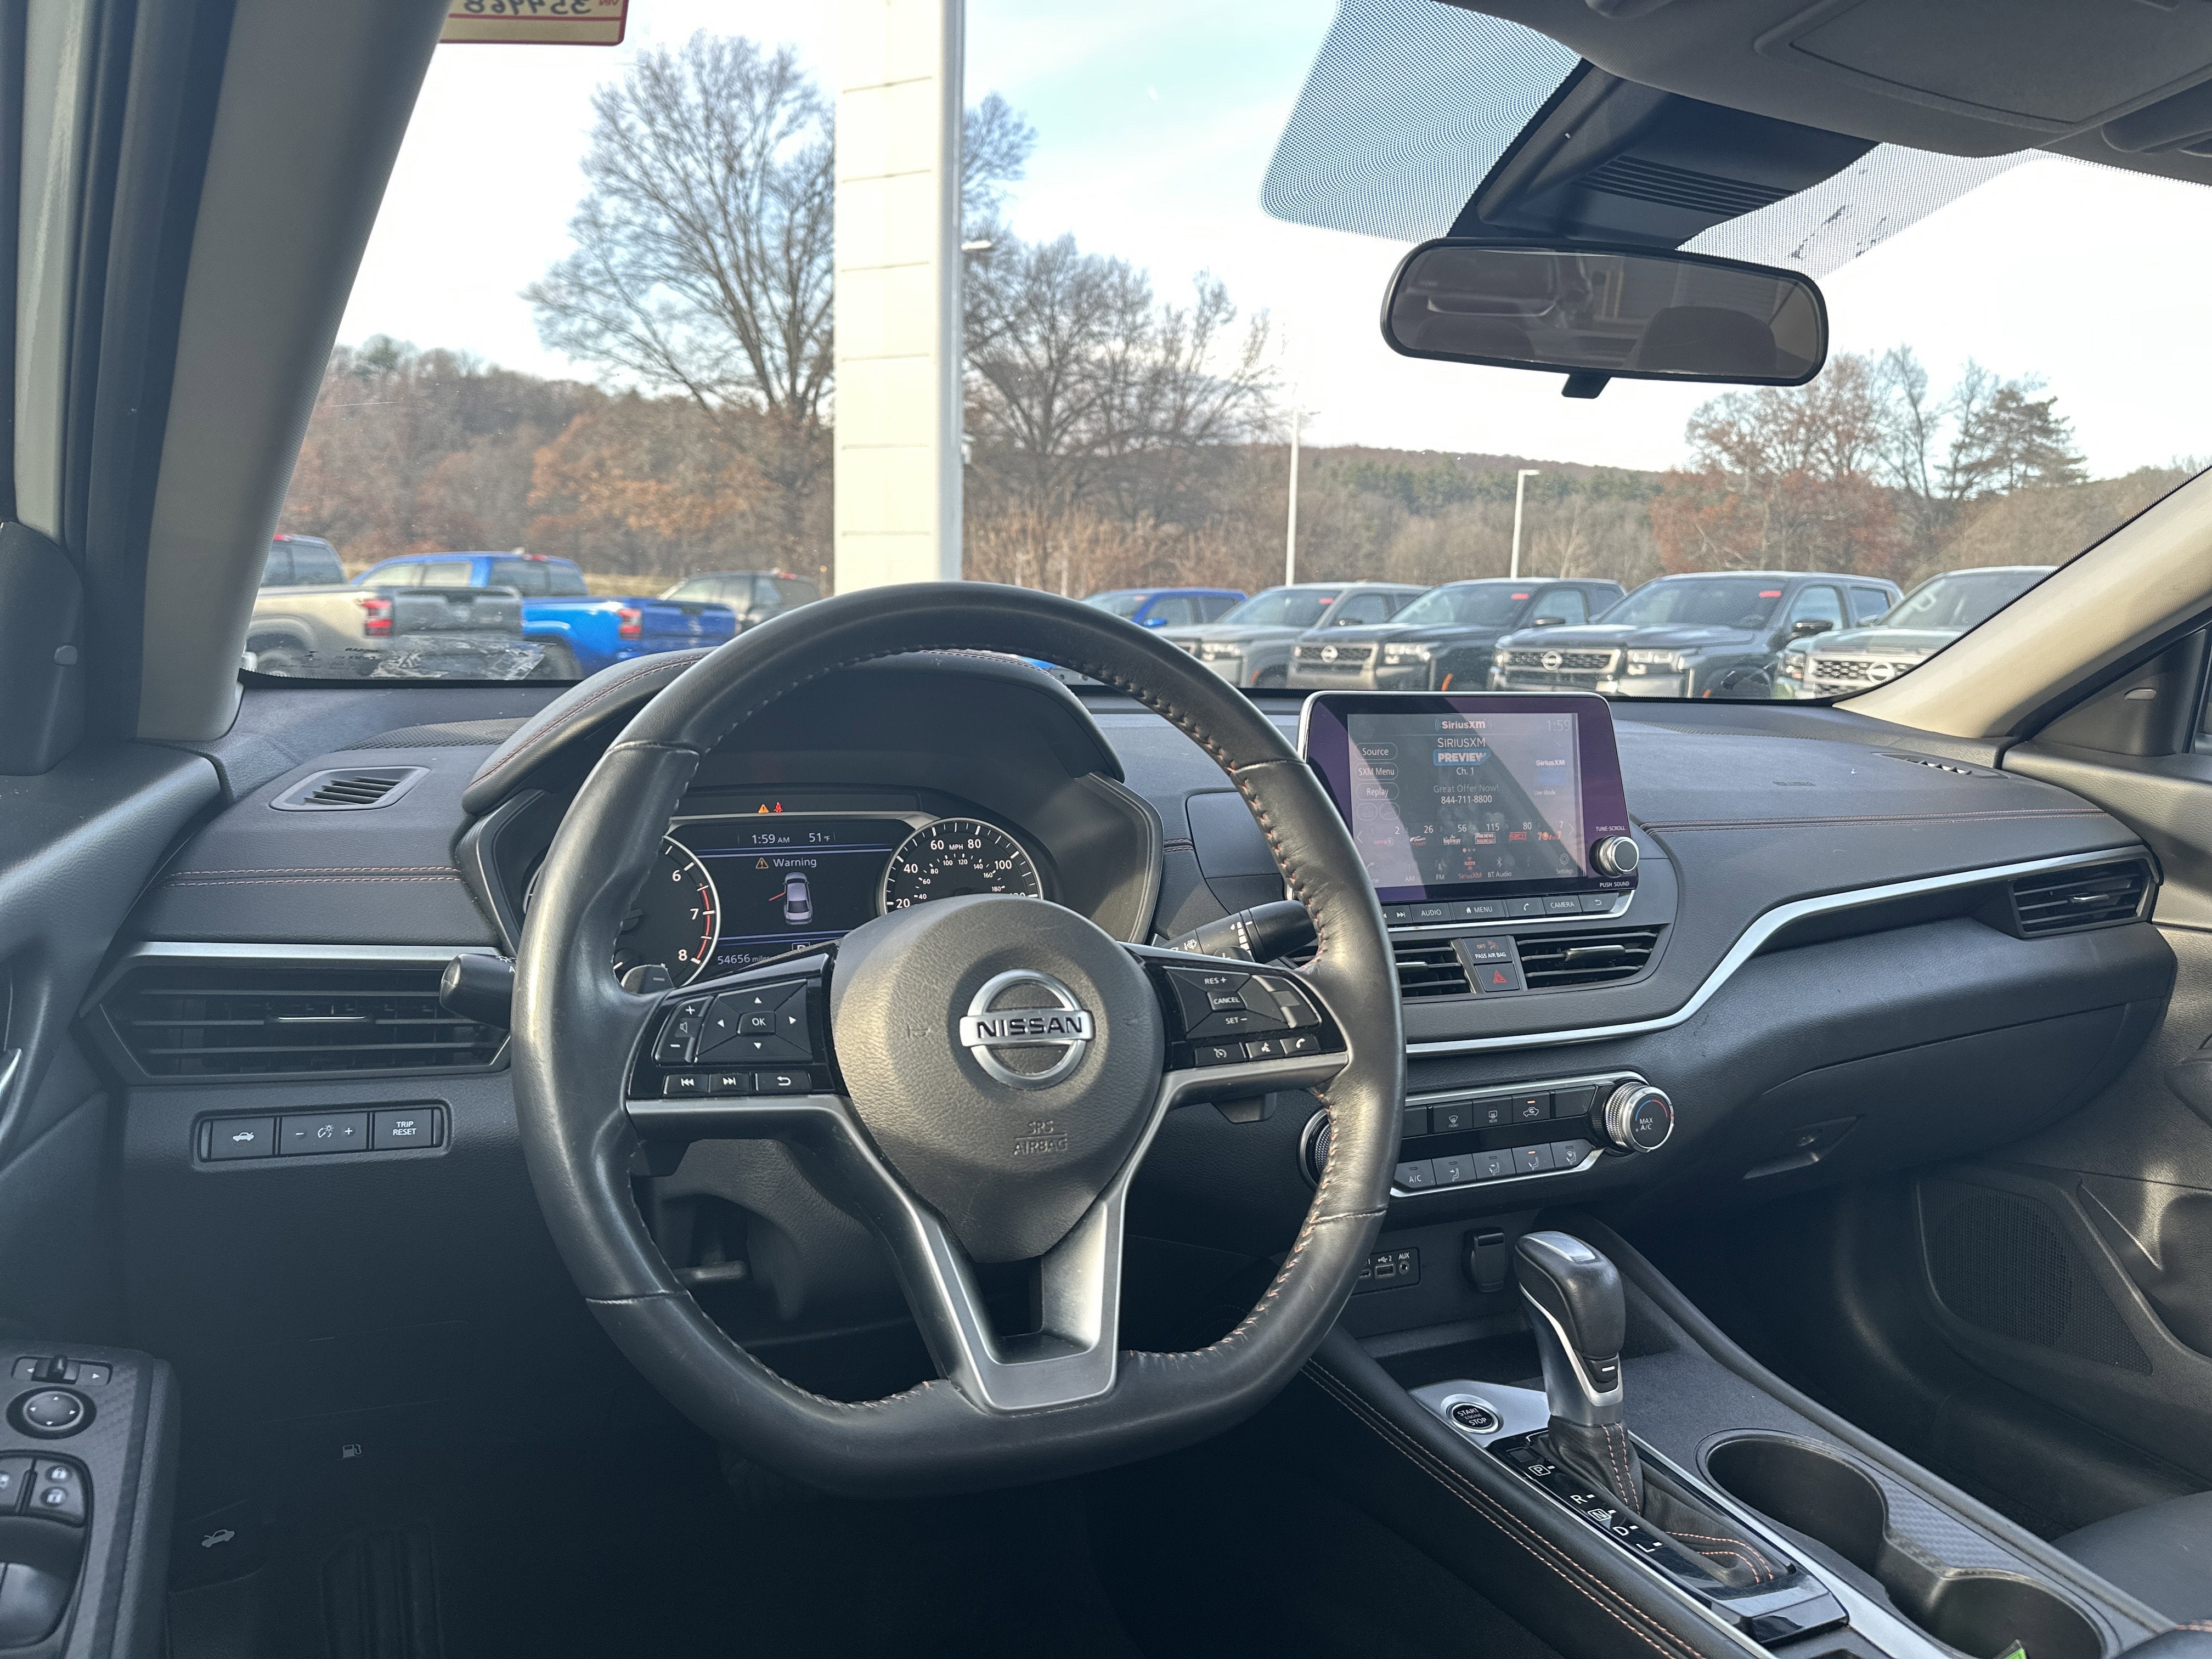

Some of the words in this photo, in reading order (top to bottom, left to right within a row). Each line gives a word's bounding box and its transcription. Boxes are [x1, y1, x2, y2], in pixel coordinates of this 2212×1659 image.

[1547, 719, 1571, 731] 1:59
[1437, 737, 1486, 748] SIRIUSXM
[1362, 747, 1389, 756] Source
[1358, 768, 1374, 776] SXM
[1375, 768, 1395, 776] Menu
[1367, 788, 1389, 797] Replay
[1434, 785, 1454, 793] Great
[1457, 785, 1477, 793] Offer
[1479, 784, 1499, 792] Now!
[1441, 795, 1492, 804] 844-711-8800
[1424, 825, 1434, 833] 26
[1457, 824, 1467, 832] 56
[1486, 823, 1500, 832] 115
[1522, 822, 1532, 830] 80
[1559, 821, 1564, 829] 7
[1395, 826, 1400, 834] 2
[751, 833, 776, 844] 1:59
[809, 832, 822, 843] 51
[930, 839, 944, 850] 60
[967, 838, 981, 849] 80
[773, 857, 817, 868] Warning
[994, 860, 1012, 870] 100
[903, 863, 918, 874] 40
[672, 870, 681, 882] 6
[896, 898, 911, 909] 20
[690, 908, 699, 921] 7
[678, 949, 687, 961] 8
[717, 953, 751, 965] 54656
[1213, 996, 1240, 1005] CANCEL
[752, 1017, 766, 1026] OK
[977, 1017, 1083, 1039] NISSAN
[1014, 1137, 1068, 1155] AIRBAG
[1409, 1175, 1422, 1183] A/C
[1398, 1252, 1410, 1260] AUX
[1457, 1408, 1479, 1417] START
[1469, 1417, 1487, 1426] STOP
[1570, 1494, 1588, 1504] R
[1612, 1526, 1630, 1536] D
[1635, 1543, 1655, 1553] L
